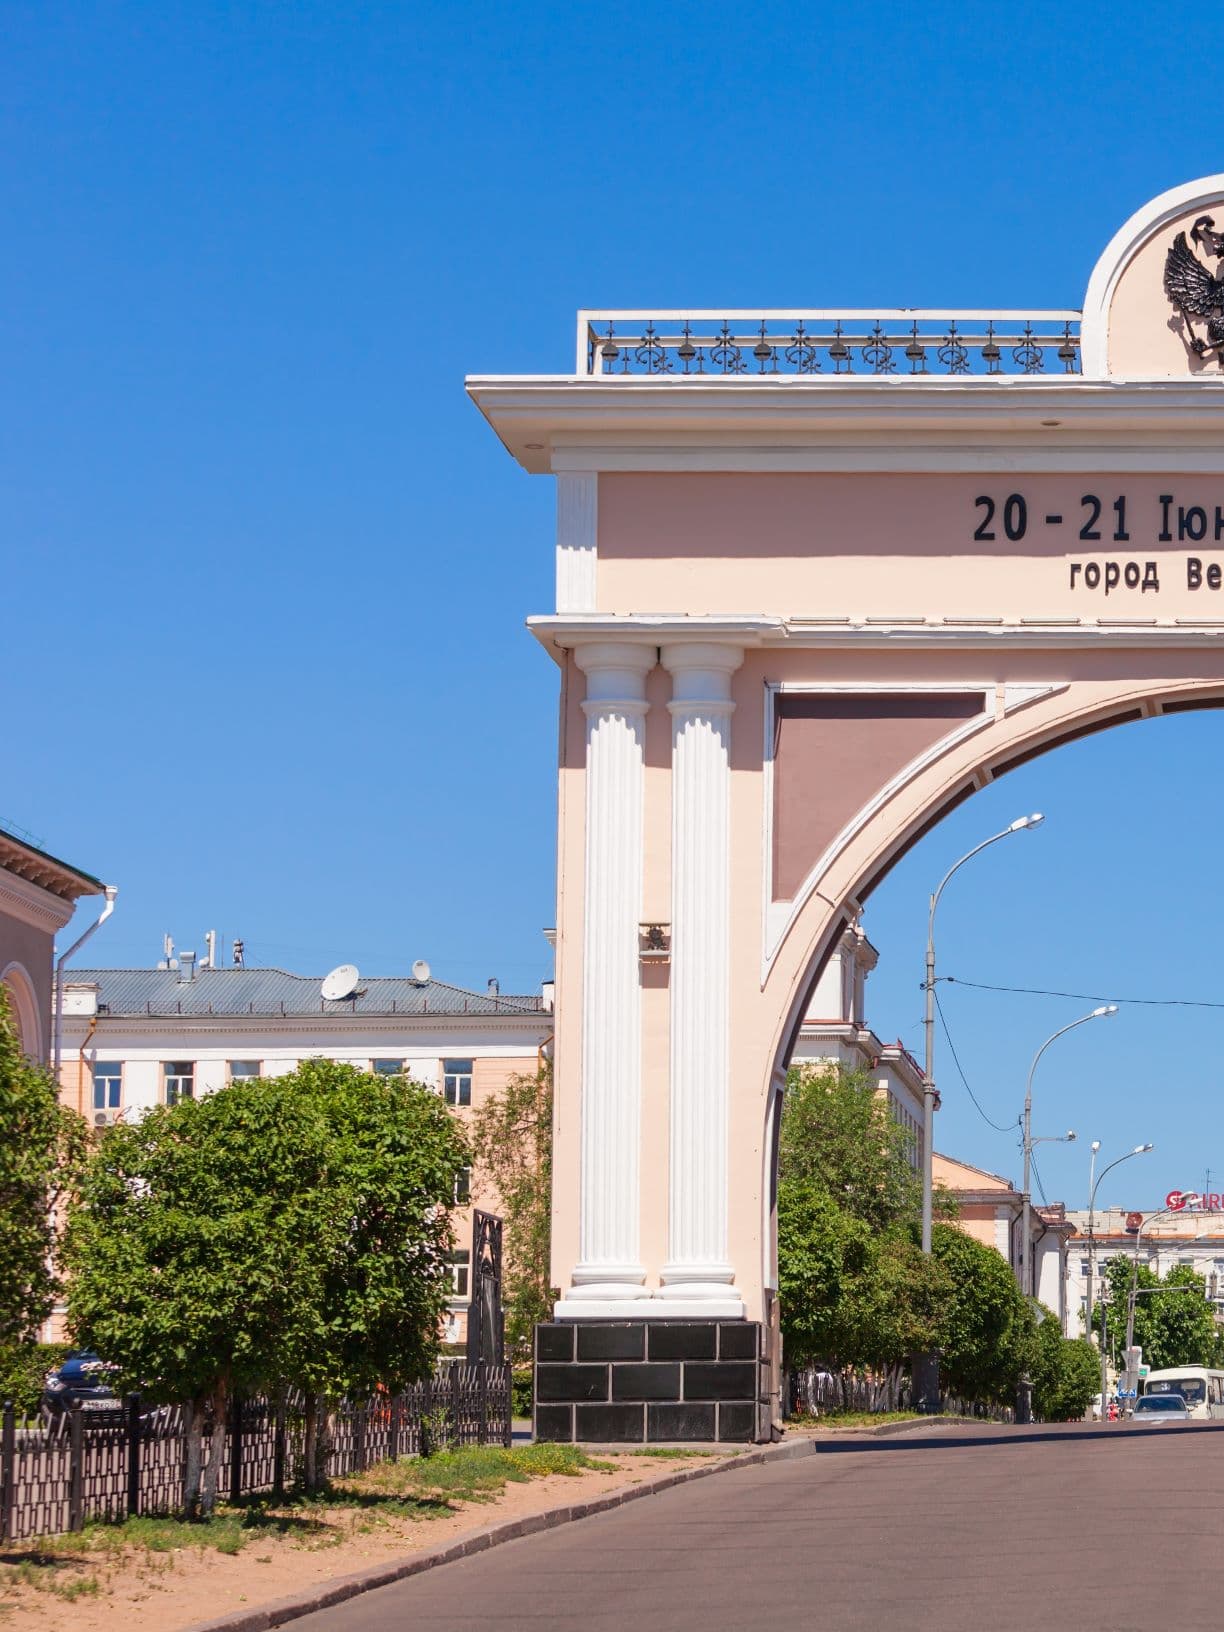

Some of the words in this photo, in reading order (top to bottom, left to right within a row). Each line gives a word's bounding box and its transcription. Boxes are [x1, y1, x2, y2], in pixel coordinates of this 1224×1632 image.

[973, 492, 1028, 542] 20
[1045, 515, 1063, 524] -
[1079, 494, 1130, 542] 21
[1070, 560, 1160, 596] город
